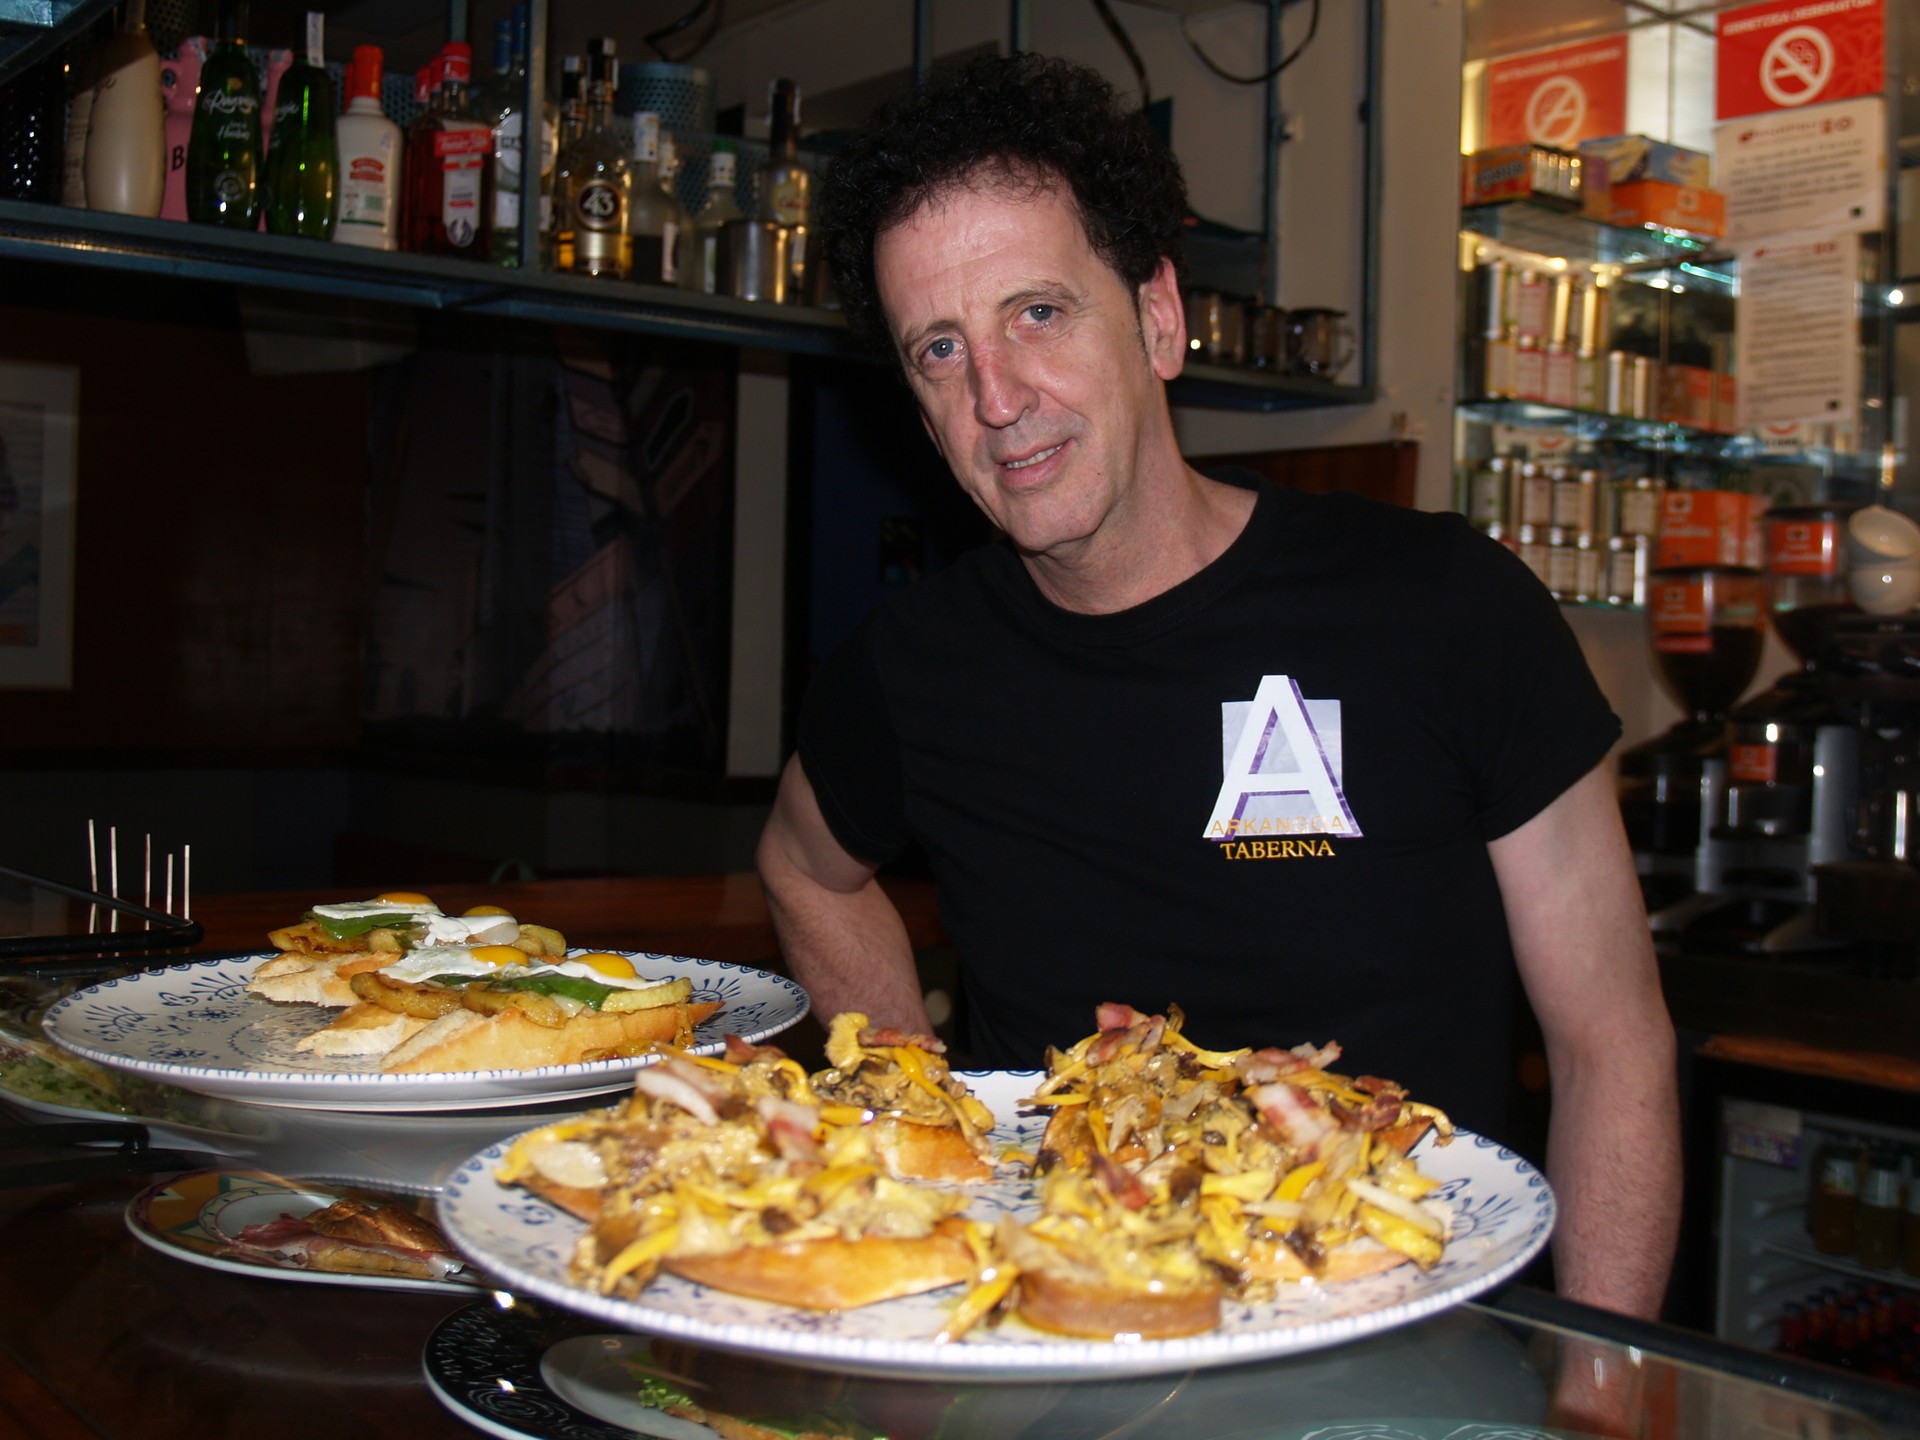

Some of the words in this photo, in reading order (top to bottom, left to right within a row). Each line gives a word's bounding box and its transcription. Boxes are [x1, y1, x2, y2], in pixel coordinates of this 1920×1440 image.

[583, 187, 615, 216] 43
[1210, 816, 1345, 836] ARKANGOA
[1220, 841, 1336, 861] TABERNA
